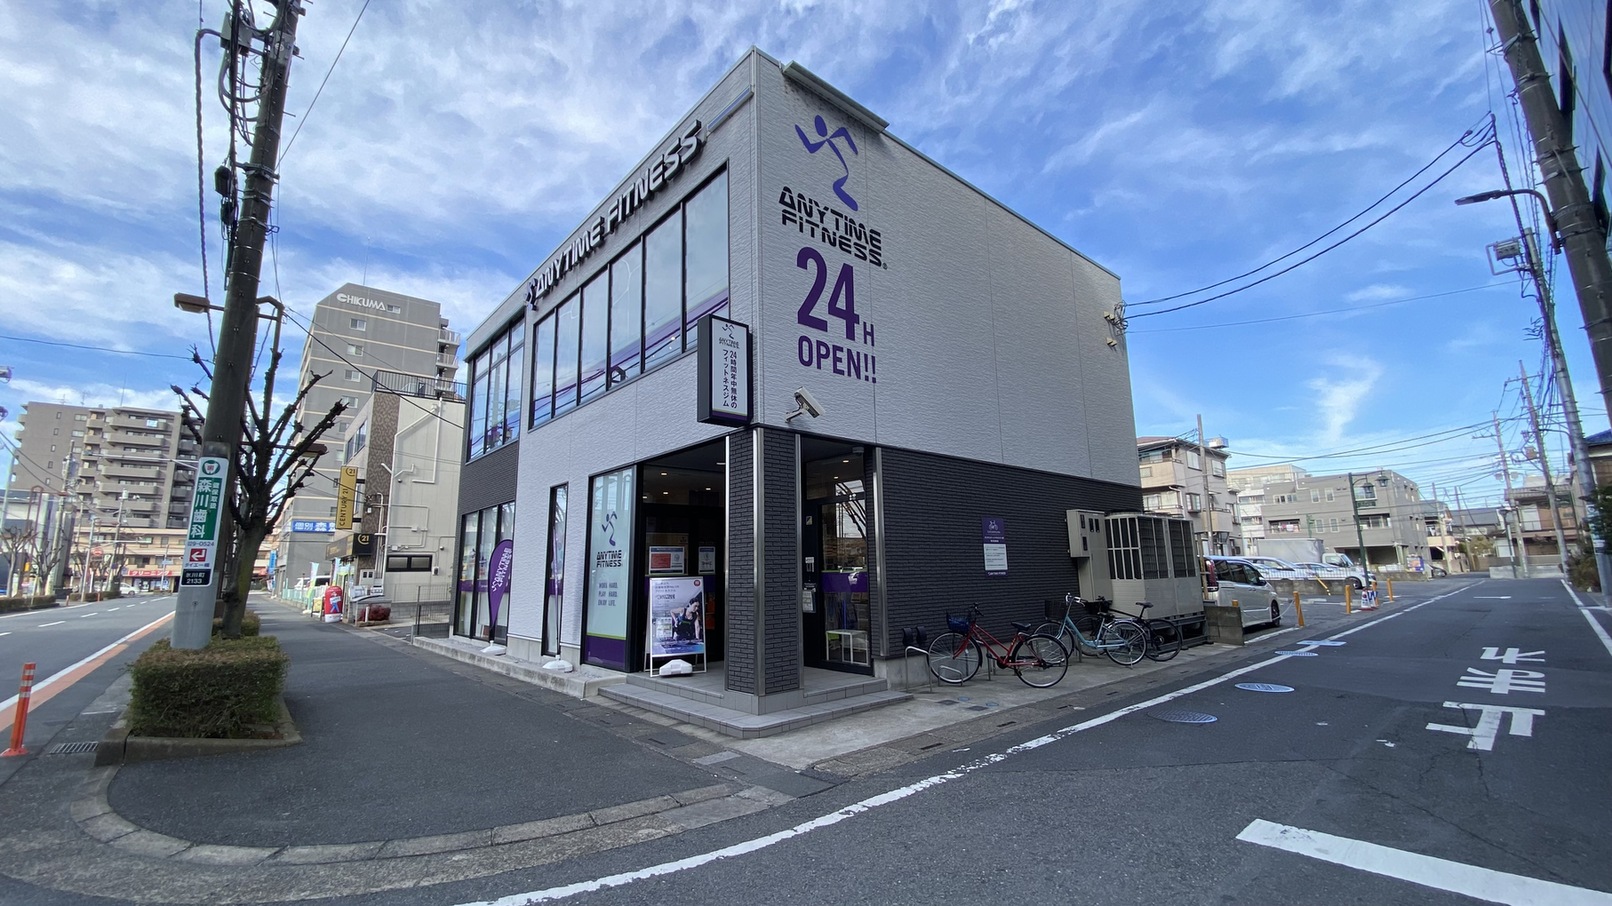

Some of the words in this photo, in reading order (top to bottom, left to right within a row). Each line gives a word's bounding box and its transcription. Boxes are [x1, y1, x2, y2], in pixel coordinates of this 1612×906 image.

[535, 216, 604, 298] ANYTIME
[607, 119, 702, 234] FITNESS
[779, 186, 881, 251] ANYTIME
[782, 208, 882, 268] FITNESS
[336, 293, 386, 311] CHIKUMA
[718, 337, 740, 346] ANYTIME
[798, 335, 877, 384] OPEN!!
[191, 479, 212, 538] 森川歯科
[339, 496, 348, 527] CENTURY
[596, 550, 622, 560] ANYTIME
[596, 560, 622, 568] FITNESS
